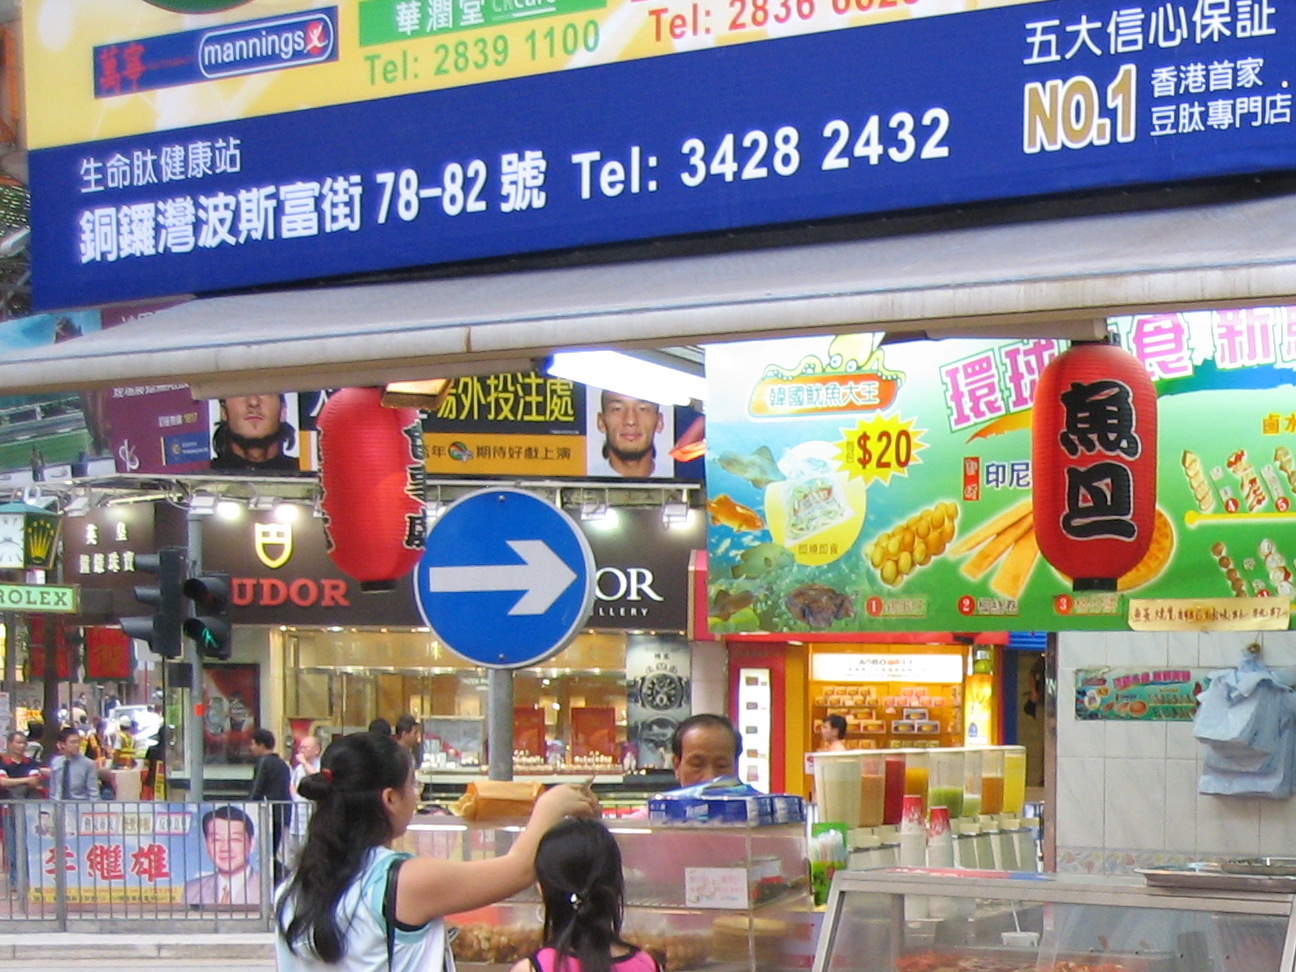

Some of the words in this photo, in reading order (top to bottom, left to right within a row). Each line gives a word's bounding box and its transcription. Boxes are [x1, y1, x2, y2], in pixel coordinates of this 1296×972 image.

[395, 0, 486, 36] 華潤堂
[648, 3, 712, 42] Tel:
[1023, 0, 1278, 64] 五大信心保証
[204, 30, 306, 66] mannings
[364, 50, 420, 86] Tel:
[433, 34, 509, 76] 2839
[525, 20, 600, 61] 1100
[1151, 57, 1264, 98] 香港首家
[1022, 64, 1137, 154] NO.1
[1149, 93, 1293, 138] 豆肽專門店
[79, 137, 242, 194] 生命肽健康站
[79, 174, 363, 264] 銅鑼灣波斯富街
[376, 158, 487, 224] 78-82
[500, 150, 548, 213] 號
[572, 145, 657, 199] Tel:
[680, 126, 800, 187] 3428
[821, 107, 950, 170] 2432
[941, 310, 1194, 431] 環球食
[769, 381, 881, 408] 韓國魷魚大王
[856, 428, 913, 470] $20
[985, 461, 1031, 489] 印尼
[231, 578, 351, 607] UDOR
